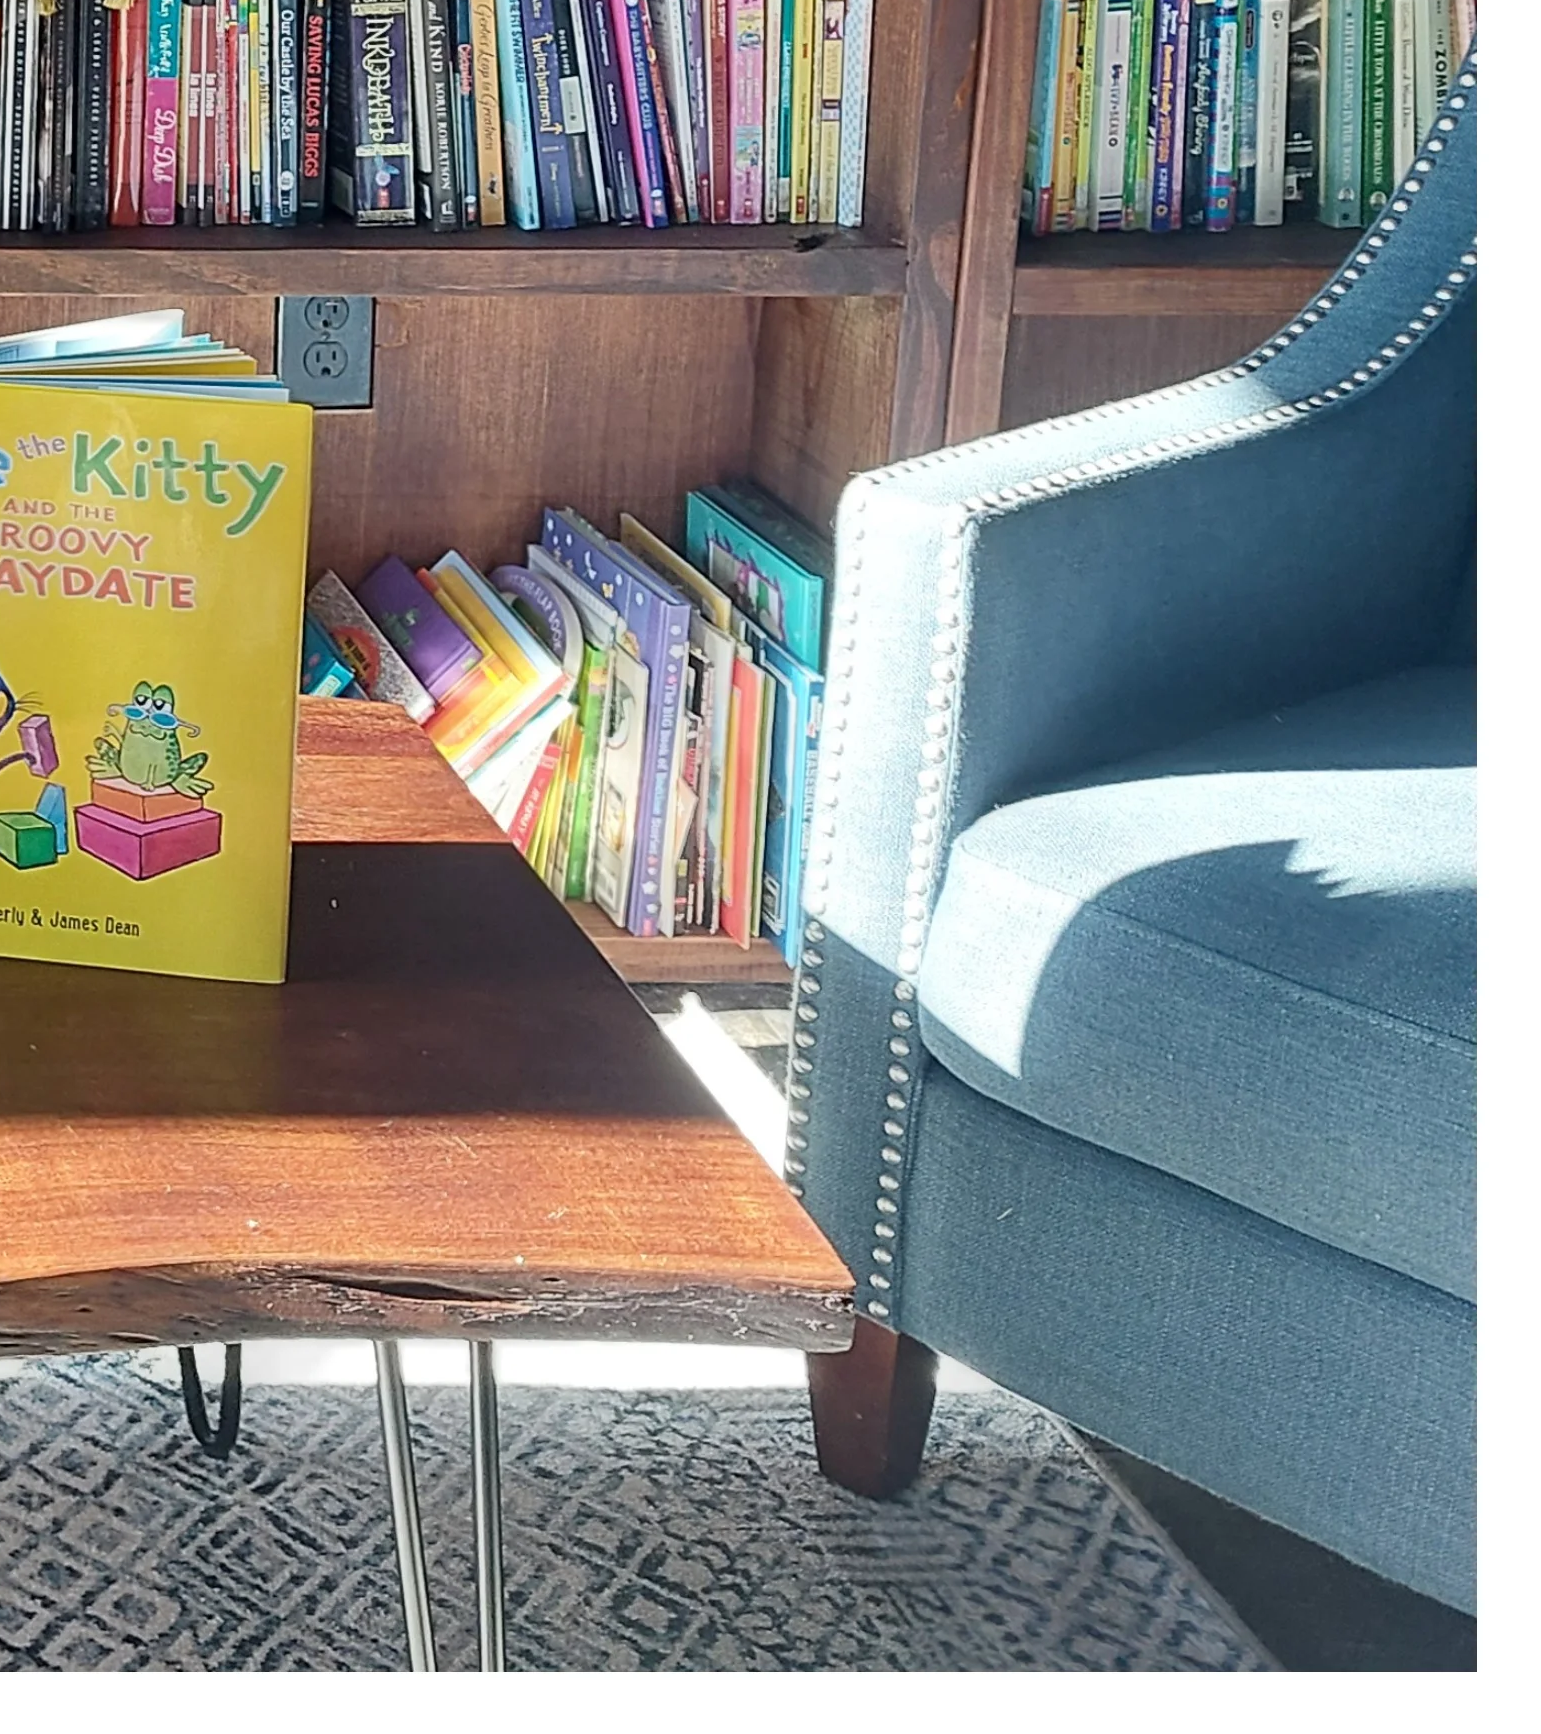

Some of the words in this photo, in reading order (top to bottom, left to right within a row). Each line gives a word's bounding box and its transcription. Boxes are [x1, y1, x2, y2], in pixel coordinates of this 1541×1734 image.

[308, 16, 323, 73] SAVING
[306, 78, 321, 126] LUCAS
[363, 18, 395, 142] INKDEATH
[304, 132, 319, 177] BIGGS
[1373, 125, 1384, 184] CROSSROADS
[17, 432, 67, 462] the
[74, 432, 286, 536] Kitty
[3, 498, 56, 518] AND
[71, 503, 115, 522] THE
[548, 611, 562, 648] BOOK
[31, 908, 44, 927] &
[49, 911, 99, 934] James
[106, 916, 140, 937] Dean
